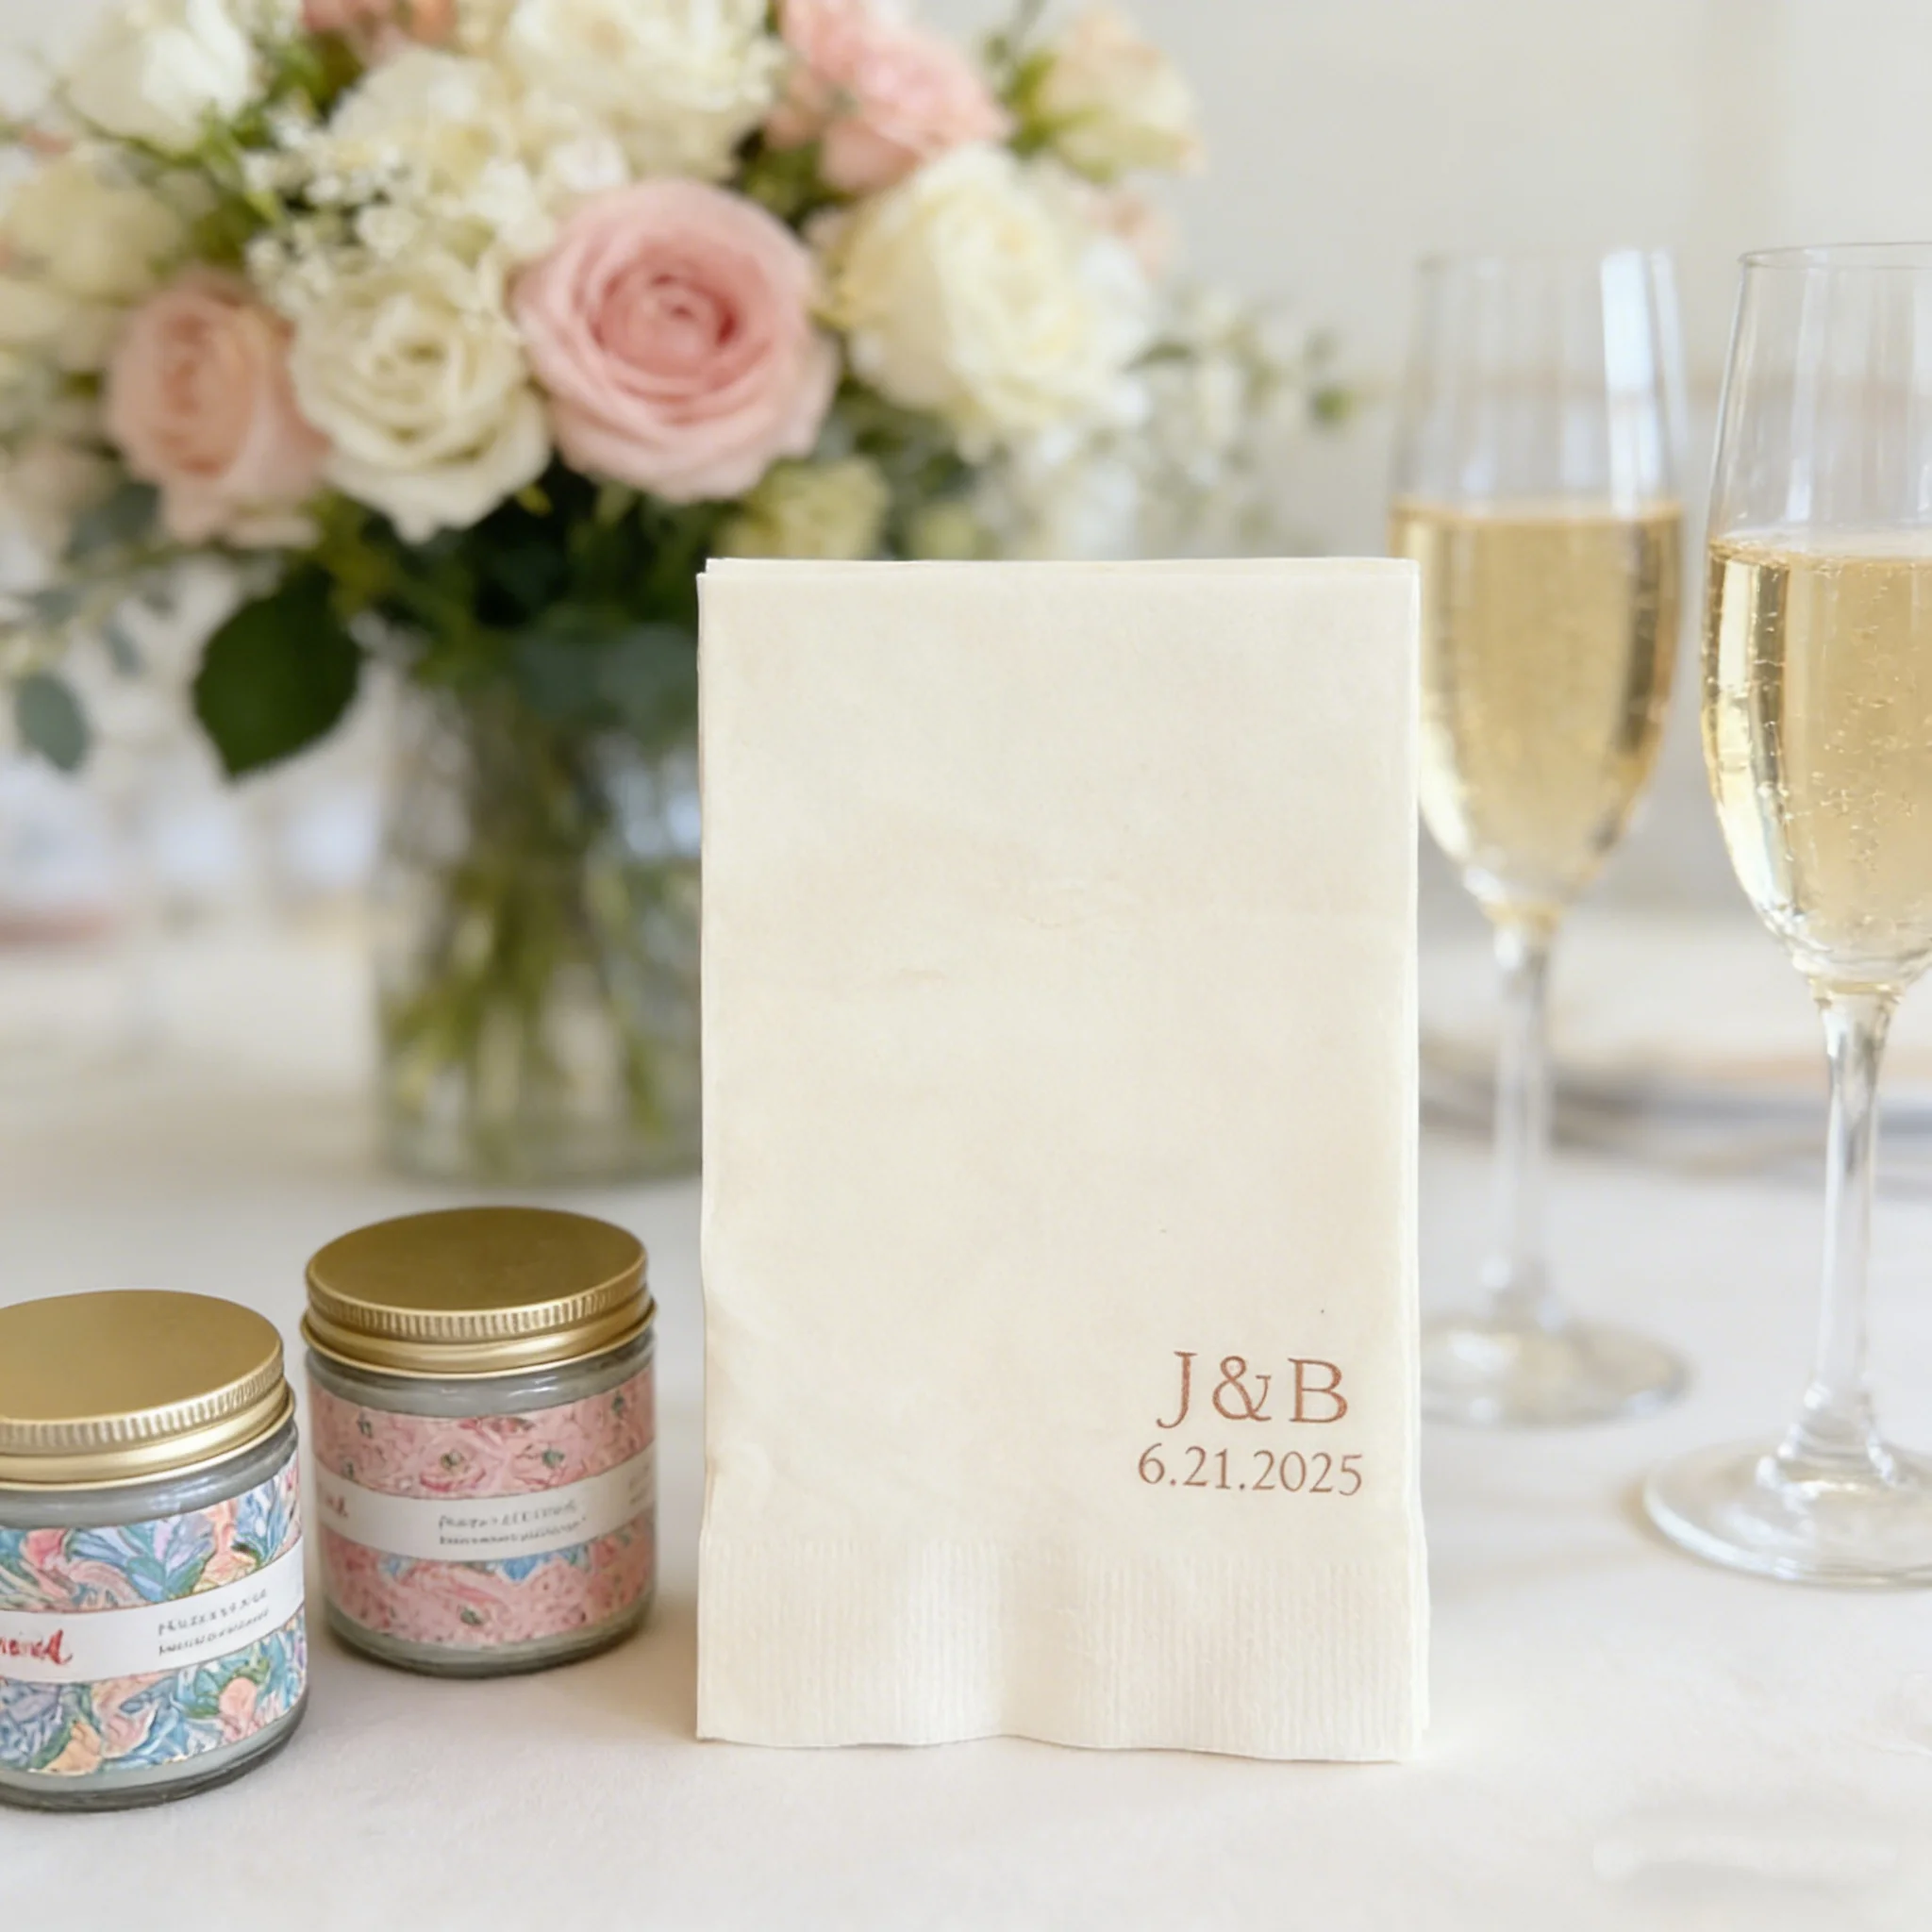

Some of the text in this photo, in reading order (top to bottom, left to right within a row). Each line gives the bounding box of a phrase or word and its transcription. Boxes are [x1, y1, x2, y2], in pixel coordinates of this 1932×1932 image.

[1156, 1351, 1348, 1429] J & B
[1138, 1442, 1362, 1496] 6.21.2025
